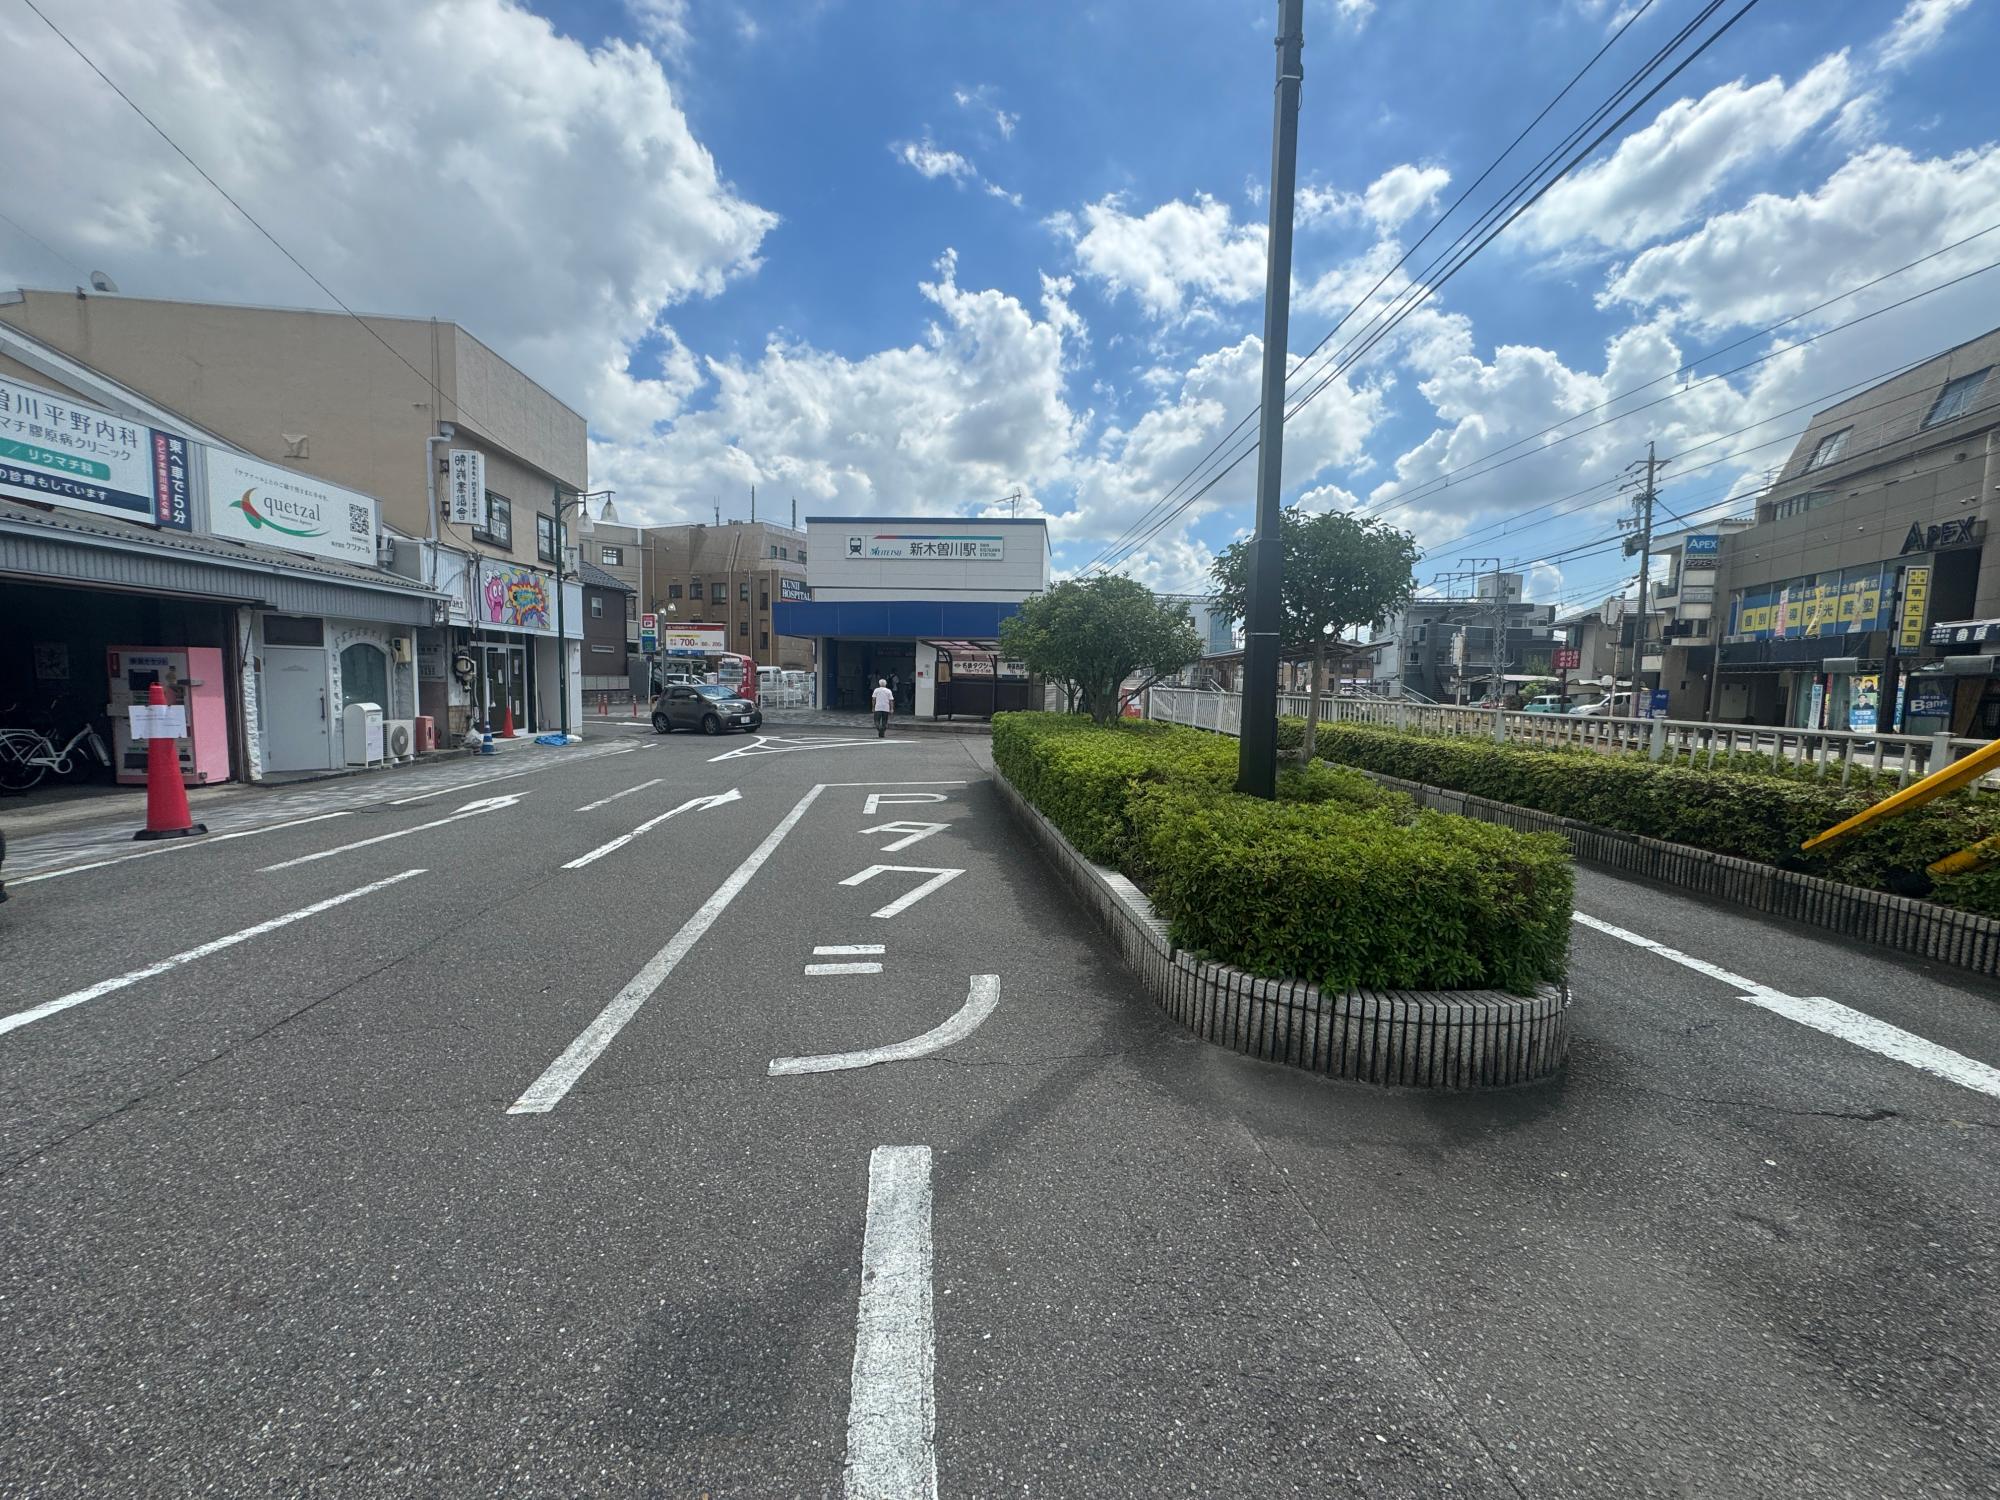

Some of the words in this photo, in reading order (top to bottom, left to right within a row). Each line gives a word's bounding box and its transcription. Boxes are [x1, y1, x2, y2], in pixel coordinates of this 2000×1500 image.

[28, 449, 94, 475] リウマチ科
[168, 438, 187, 524] 東へ車で5分
[263, 496, 321, 522] quetzal
[1688, 538, 1718, 549] APEX
[1900, 516, 1977, 555] APEX
[910, 542, 977, 557] 新木曽川駅
[782, 589, 811, 601] HOSPITAL
